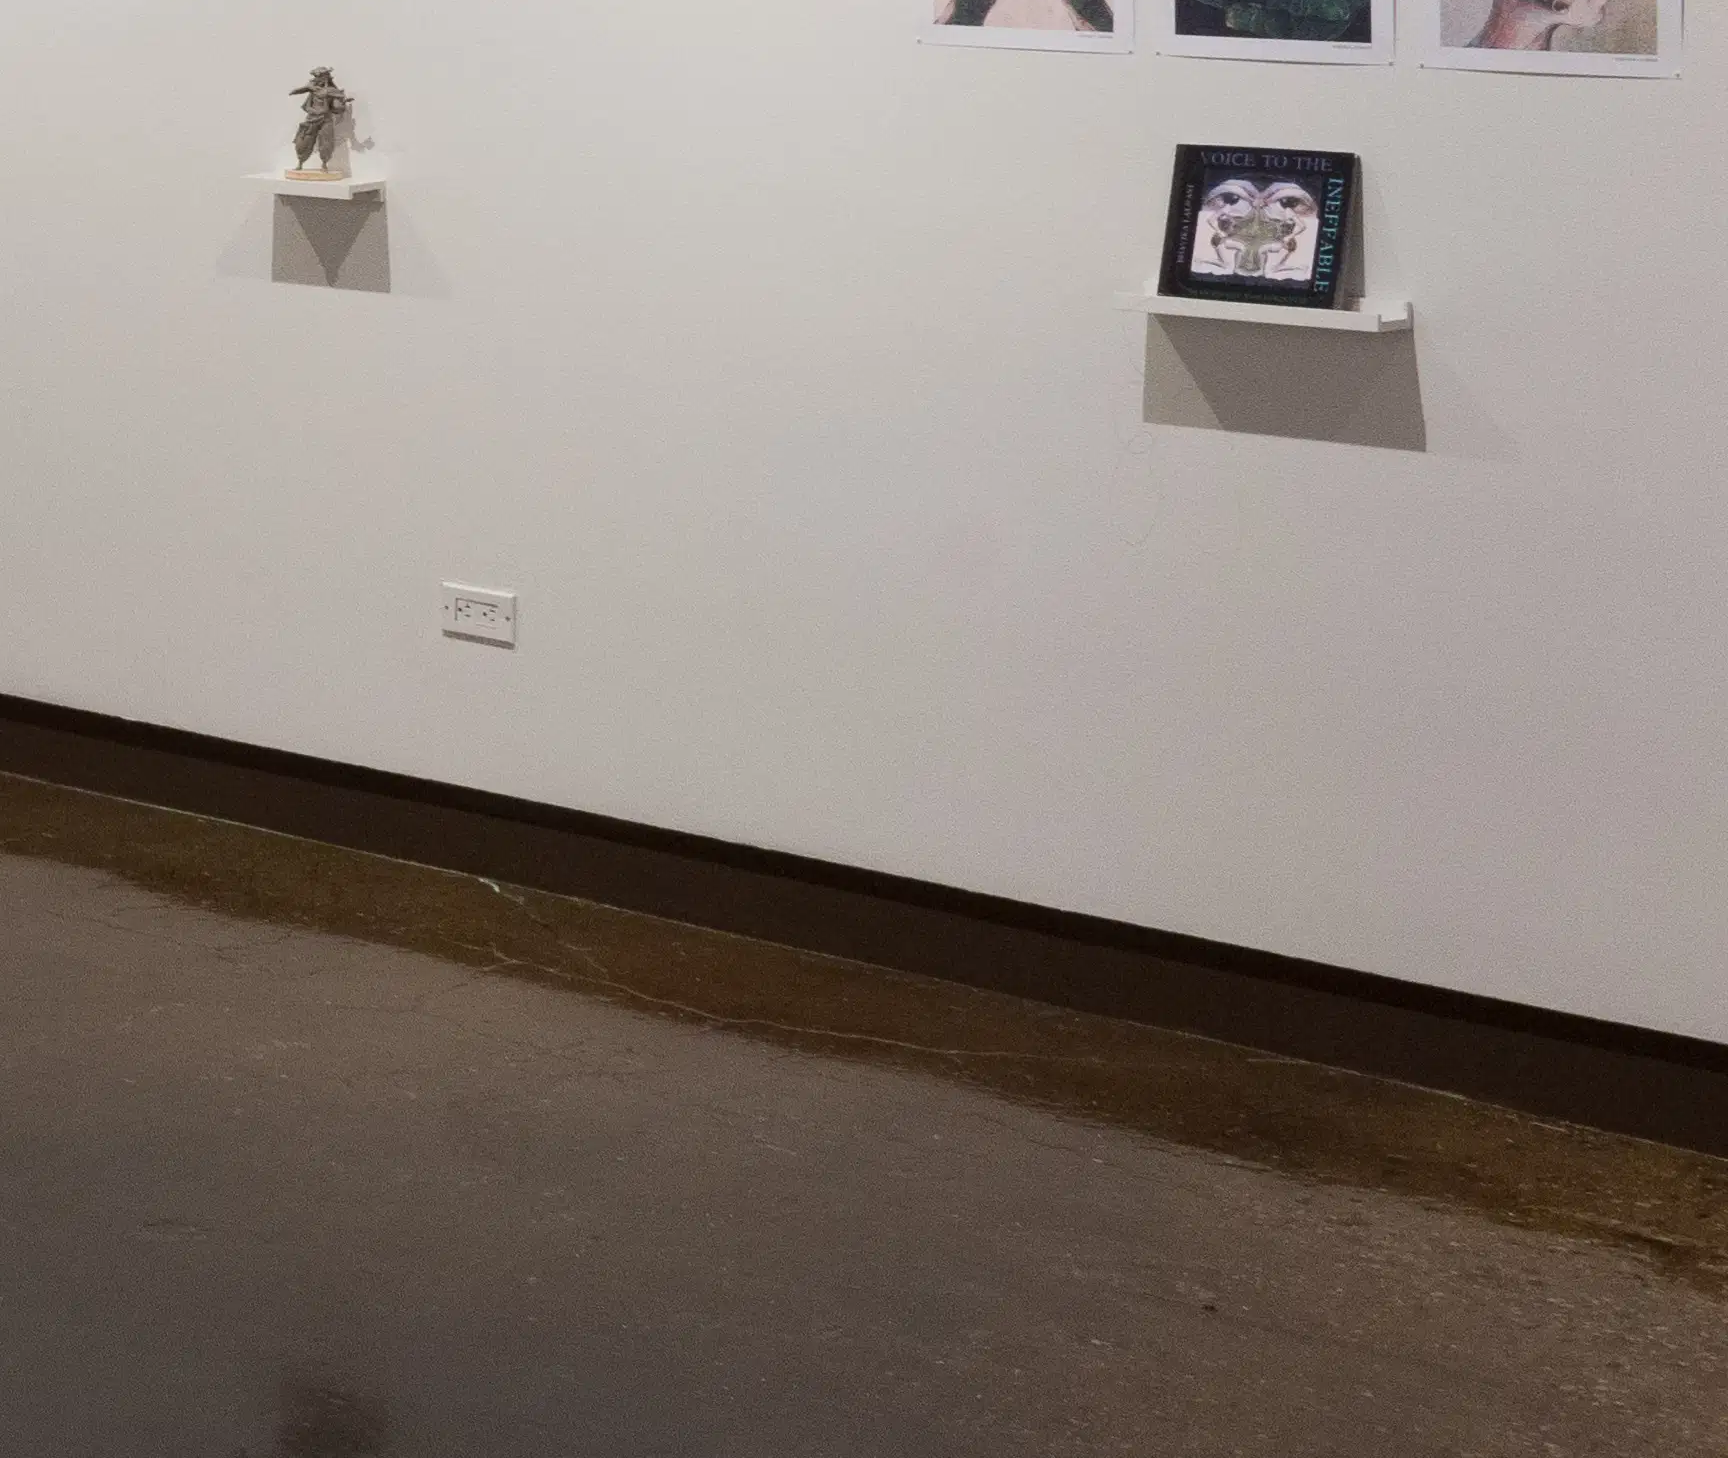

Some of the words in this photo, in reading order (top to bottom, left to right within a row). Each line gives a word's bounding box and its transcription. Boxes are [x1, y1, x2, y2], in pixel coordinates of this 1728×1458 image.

[1200, 151, 1256, 168] VOICE
[1261, 154, 1289, 170] TO
[1292, 156, 1333, 173] THE
[1313, 177, 1344, 293] INEFFABLE
